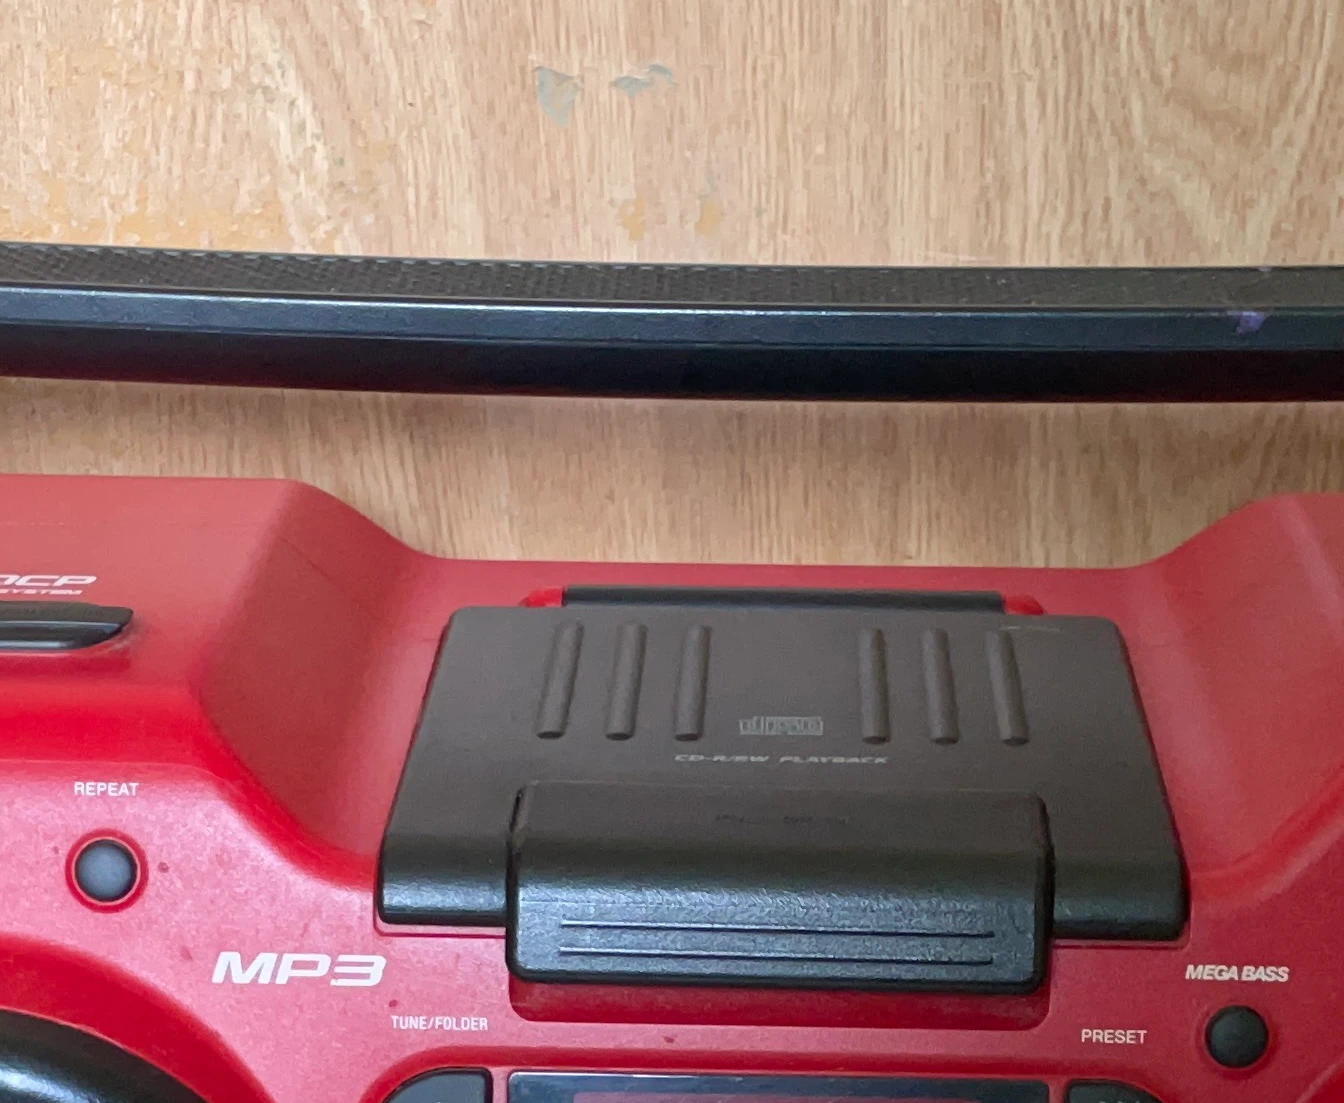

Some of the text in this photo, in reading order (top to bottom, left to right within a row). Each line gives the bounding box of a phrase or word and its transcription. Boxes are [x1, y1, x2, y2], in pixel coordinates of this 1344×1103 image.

[779, 755, 888, 764] PLAYBACK
[73, 781, 139, 797] REPEAT
[211, 951, 387, 987] MP3
[1185, 964, 1290, 983] MEGA BASS
[391, 1015, 489, 1032] TUNE/FOLDER
[1081, 1028, 1148, 1044] PRESET
